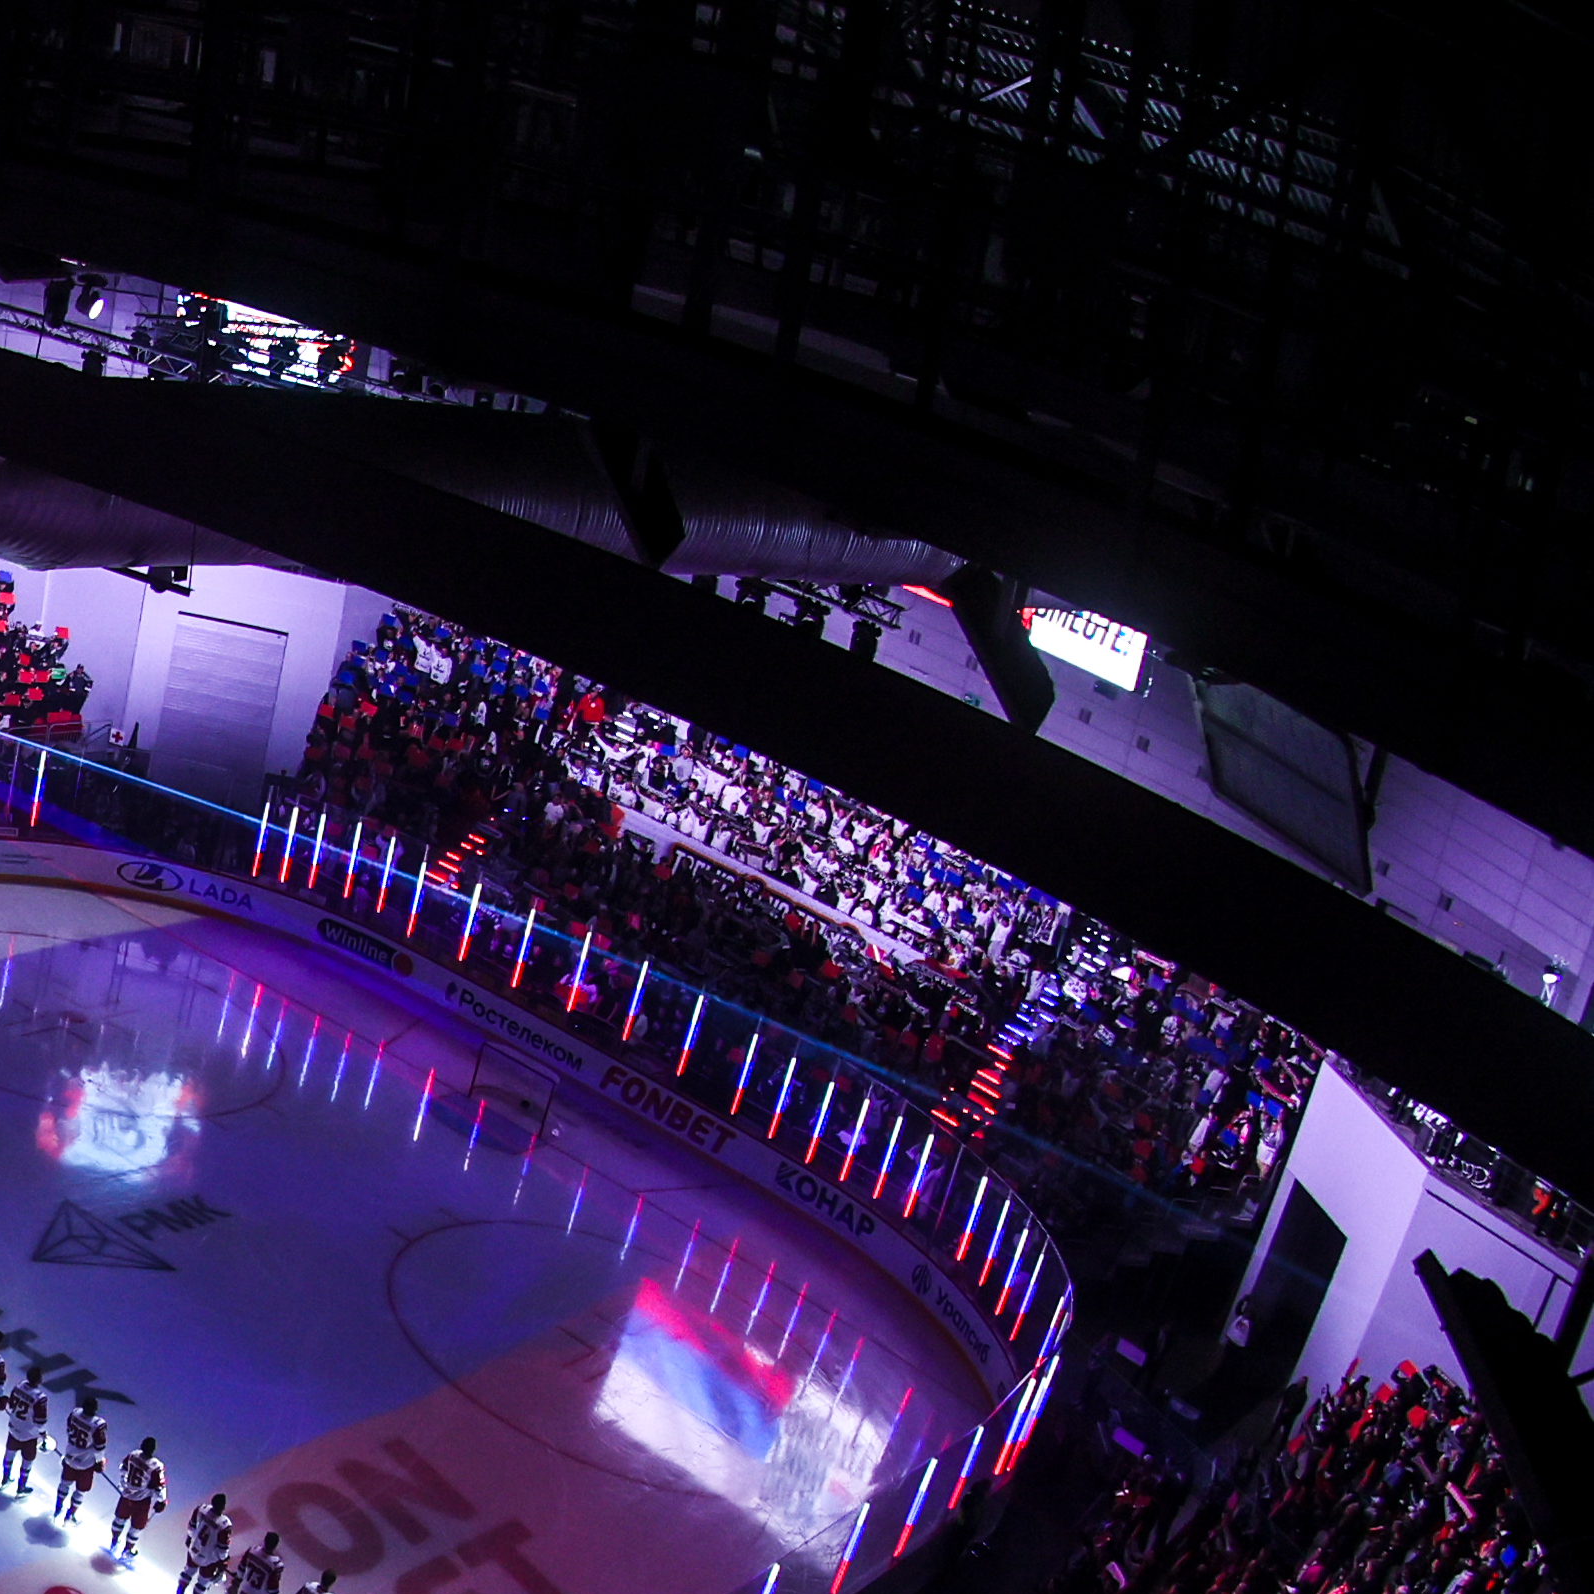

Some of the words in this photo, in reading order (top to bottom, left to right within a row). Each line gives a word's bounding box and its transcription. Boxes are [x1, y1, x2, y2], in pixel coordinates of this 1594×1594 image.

[188, 876, 253, 910] LADA
[324, 922, 390, 964] Winline
[458, 987, 584, 1073] Ростелеком
[599, 1064, 739, 1154] FONBET
[773, 1160, 876, 1239] КОНАР
[938, 1286, 992, 1363] Уралсиб
[68, 1423, 89, 1450] 26
[126, 1465, 142, 1488] 16
[218, 1434, 476, 1577] ON
[197, 1524, 210, 1546] 4
